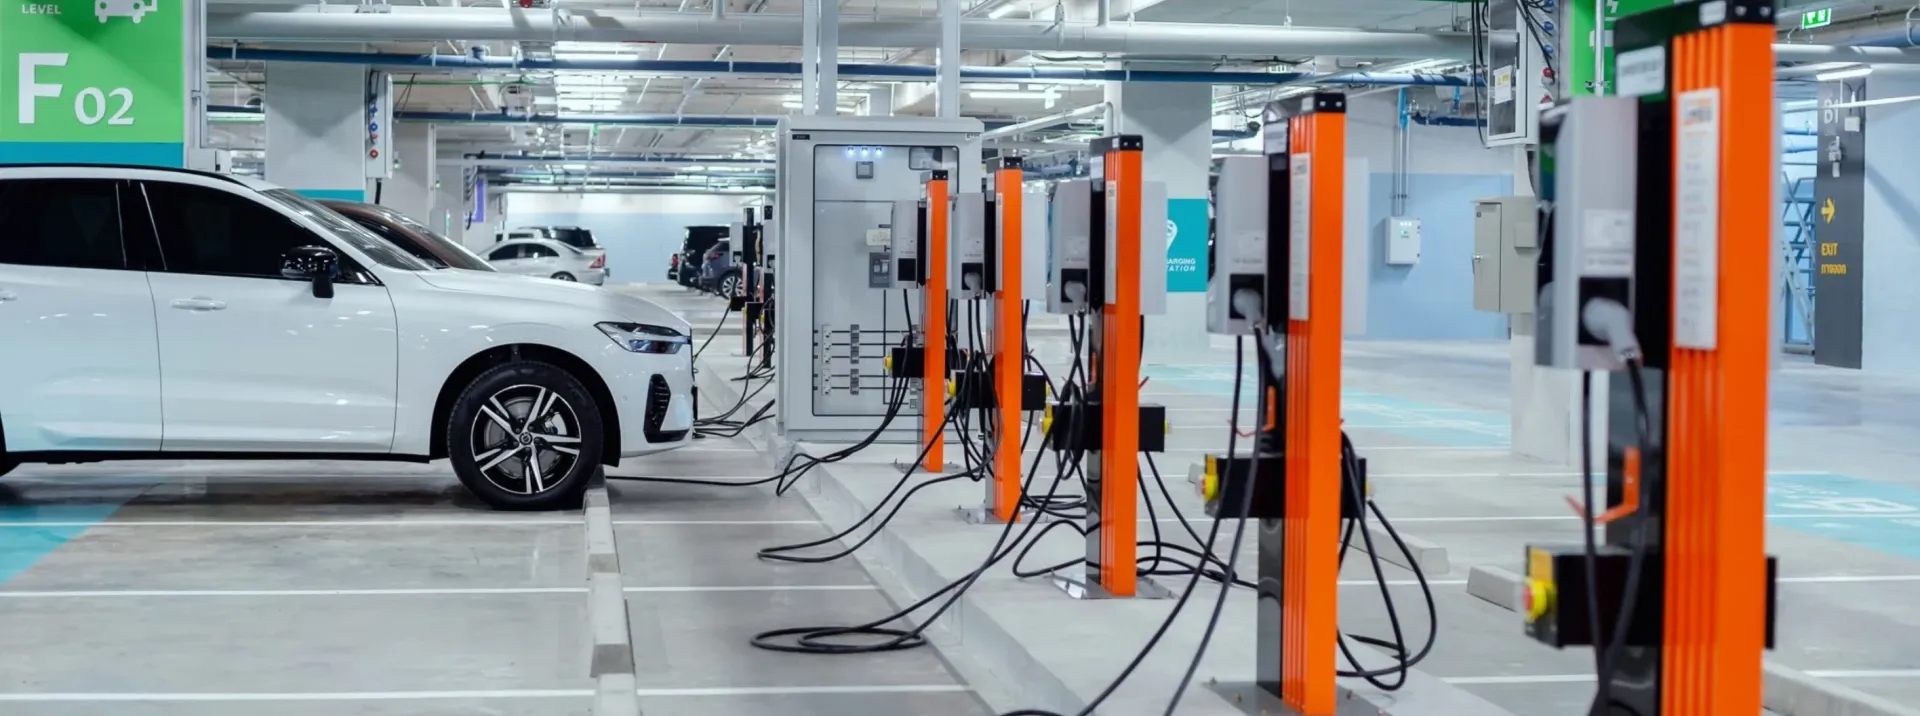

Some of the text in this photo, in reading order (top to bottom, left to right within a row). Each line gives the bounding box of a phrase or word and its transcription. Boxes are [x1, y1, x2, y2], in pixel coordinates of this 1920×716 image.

[22, 4, 62, 14] LEVEL
[18, 52, 135, 126] F 02
[1821, 242, 1838, 257] EXIT
[1167, 257, 1195, 265] ARGING
